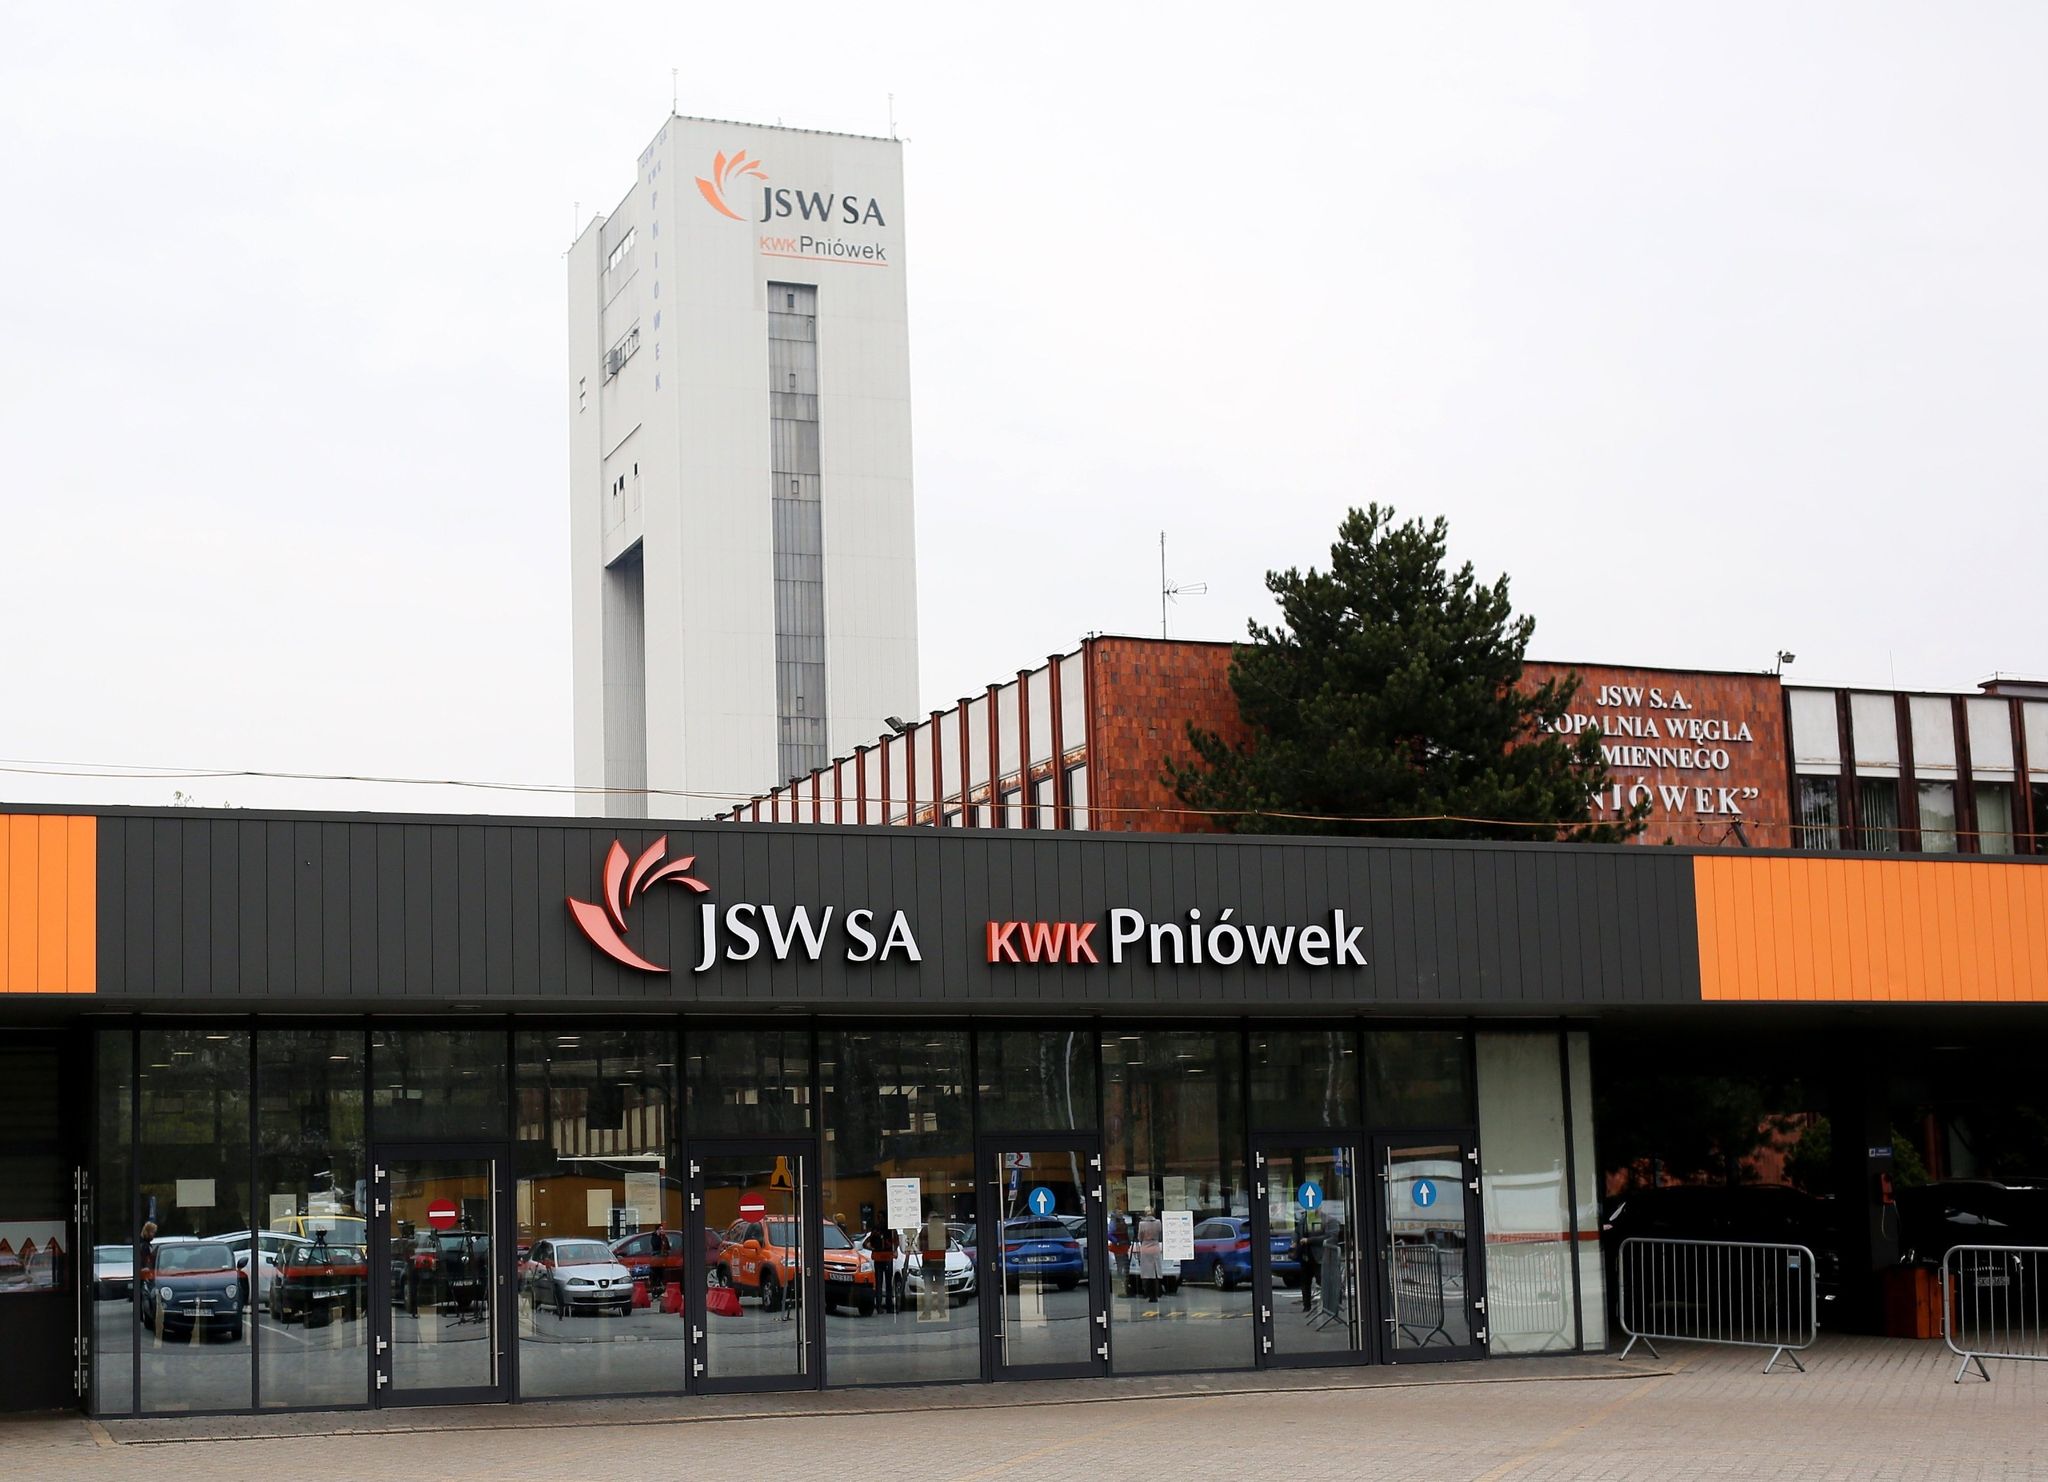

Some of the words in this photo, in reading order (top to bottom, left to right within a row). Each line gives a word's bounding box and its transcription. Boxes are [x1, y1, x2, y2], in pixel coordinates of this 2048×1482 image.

[760, 187, 834, 222] JSW
[842, 196, 885, 226] SA
[760, 236, 797, 252] KWK
[800, 235, 886, 260] Pniówek
[1597, 685, 1644, 707] JSW
[1665, 718, 1753, 745] WĘGLA
[695, 902, 834, 972] JSW
[846, 909, 922, 962] SA
[986, 920, 1099, 963] KWK
[1109, 907, 1368, 966] Pniówek
